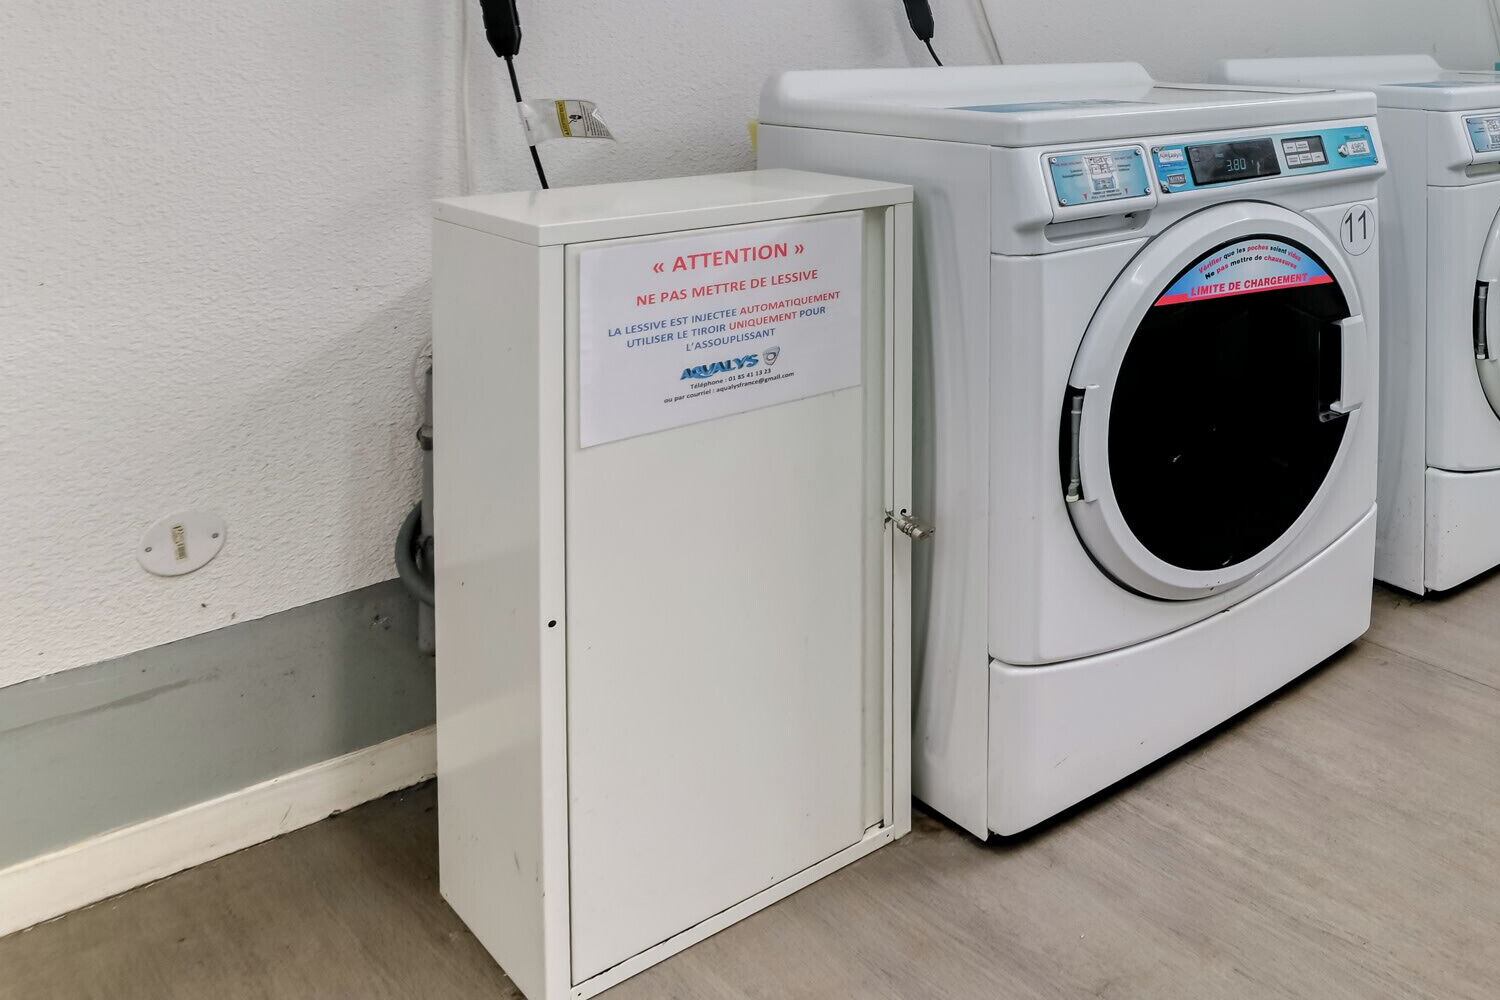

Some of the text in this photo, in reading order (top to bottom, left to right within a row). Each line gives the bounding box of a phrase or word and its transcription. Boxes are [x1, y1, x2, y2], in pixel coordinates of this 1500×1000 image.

[1226, 158, 1247, 172] 3.80
[1344, 209, 1367, 243] 11
[672, 243, 788, 272] ATTENTION
[1223, 251, 1235, 260] que
[1247, 244, 1269, 252] poches
[1270, 245, 1287, 255] soient
[1204, 271, 1215, 280] Ne
[1216, 264, 1229, 274] pas
[1230, 255, 1253, 267] mettre
[1263, 254, 1297, 269] chaussures
[636, 269, 818, 307] NE PAS METTRE DE LESSIVE
[1190, 272, 1309, 297] LIMITE DE CHARGEMENT
[608, 290, 841, 338] LA LESSIVE EST INJECTEE AUTOMATIQUEMENT
[626, 305, 827, 349] UTILISER LE TIROIR UNIQUEMENT POUR
[685, 327, 776, 352] L'ASSOUPLISSANT
[679, 353, 760, 381] AQUALYS
[674, 394, 685, 402] par
[686, 388, 712, 399] courriel
[690, 378, 724, 390] Téléphone
